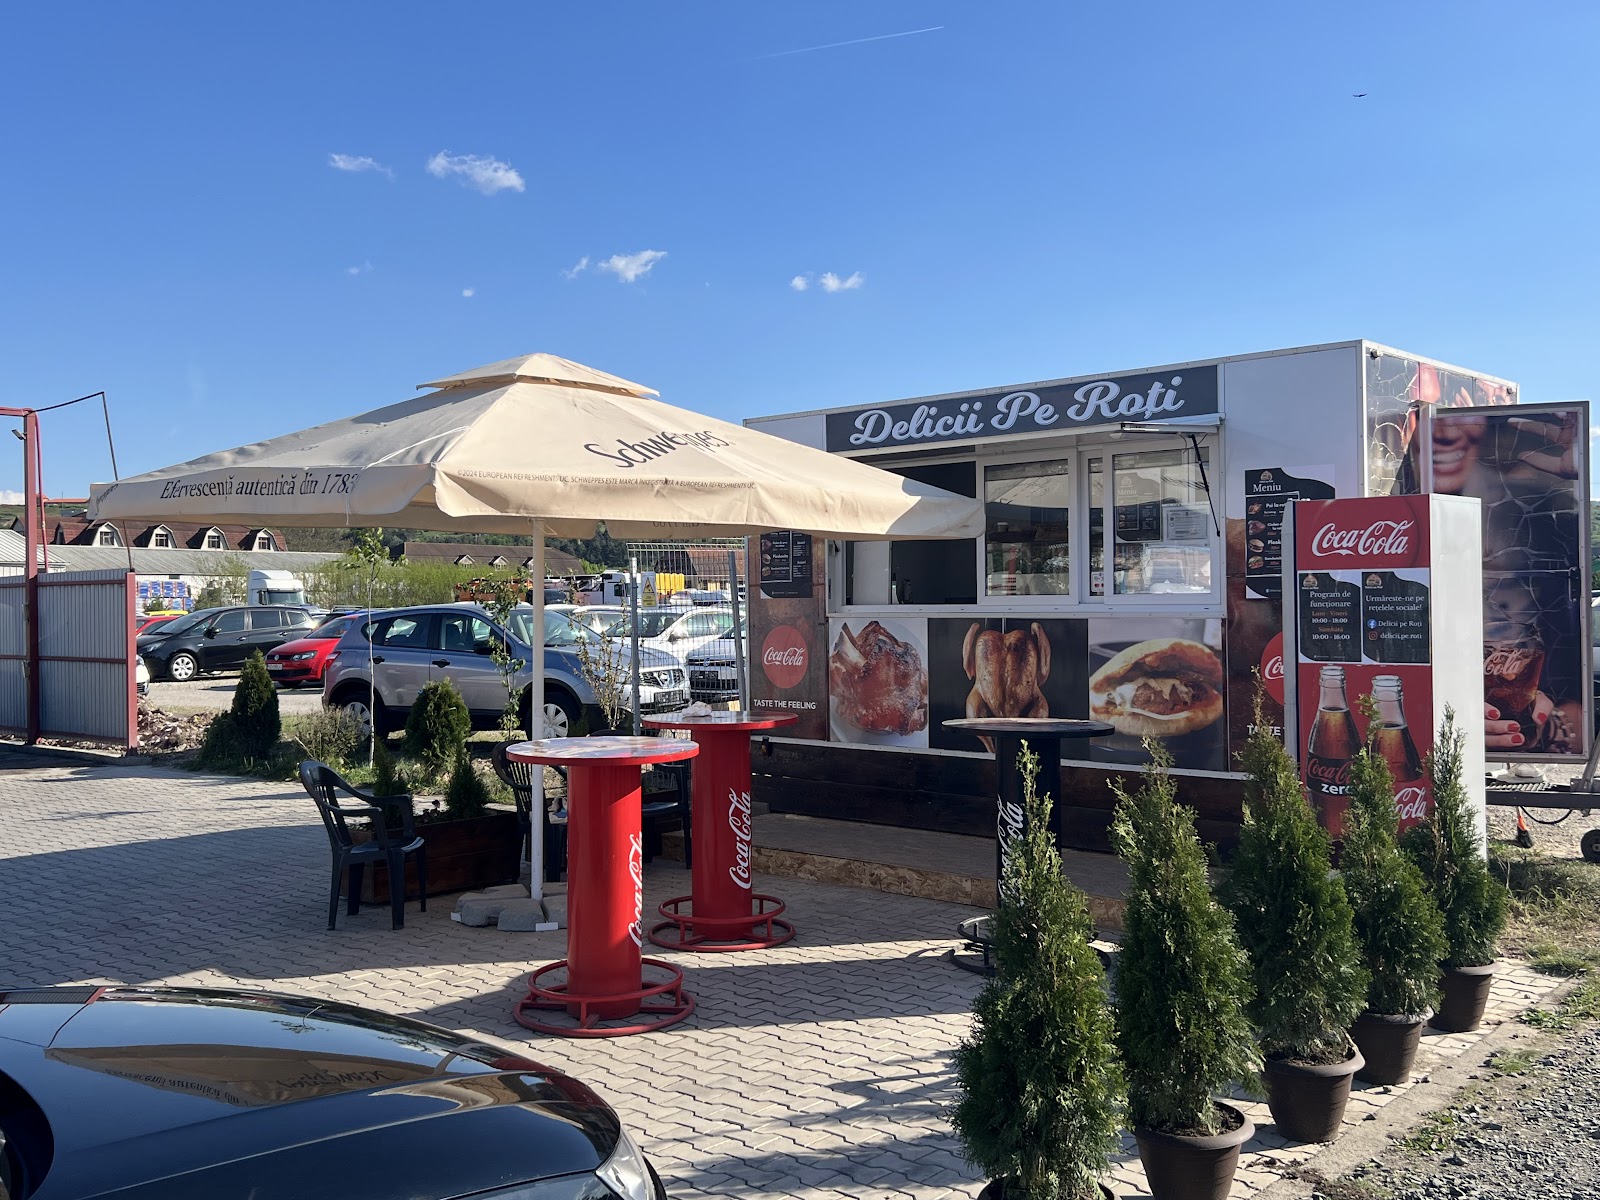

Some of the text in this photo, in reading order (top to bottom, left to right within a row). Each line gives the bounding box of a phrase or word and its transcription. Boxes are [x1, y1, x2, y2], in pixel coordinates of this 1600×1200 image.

[849, 376, 1185, 446] Delicii Pe Roți
[236, 472, 297, 497] autentică
[299, 471, 318, 495] din
[478, 470, 513, 480] EUROPEAN
[513, 472, 558, 483] REFRESHMENTS
[571, 475, 605, 485] SCHWEPPES
[605, 477, 618, 486] ESTE
[680, 480, 708, 489] EUROPEAN
[1253, 482, 1282, 493] Meniu
[1312, 520, 1414, 557] Coca-Cola
[1310, 590, 1351, 599] Program de
[1396, 603, 1422, 611] sociale!
[763, 646, 806, 666] Coca-Cola
[753, 699, 816, 710] TASTE THE FEELING
[728, 787, 751, 890] Coca-Cola
